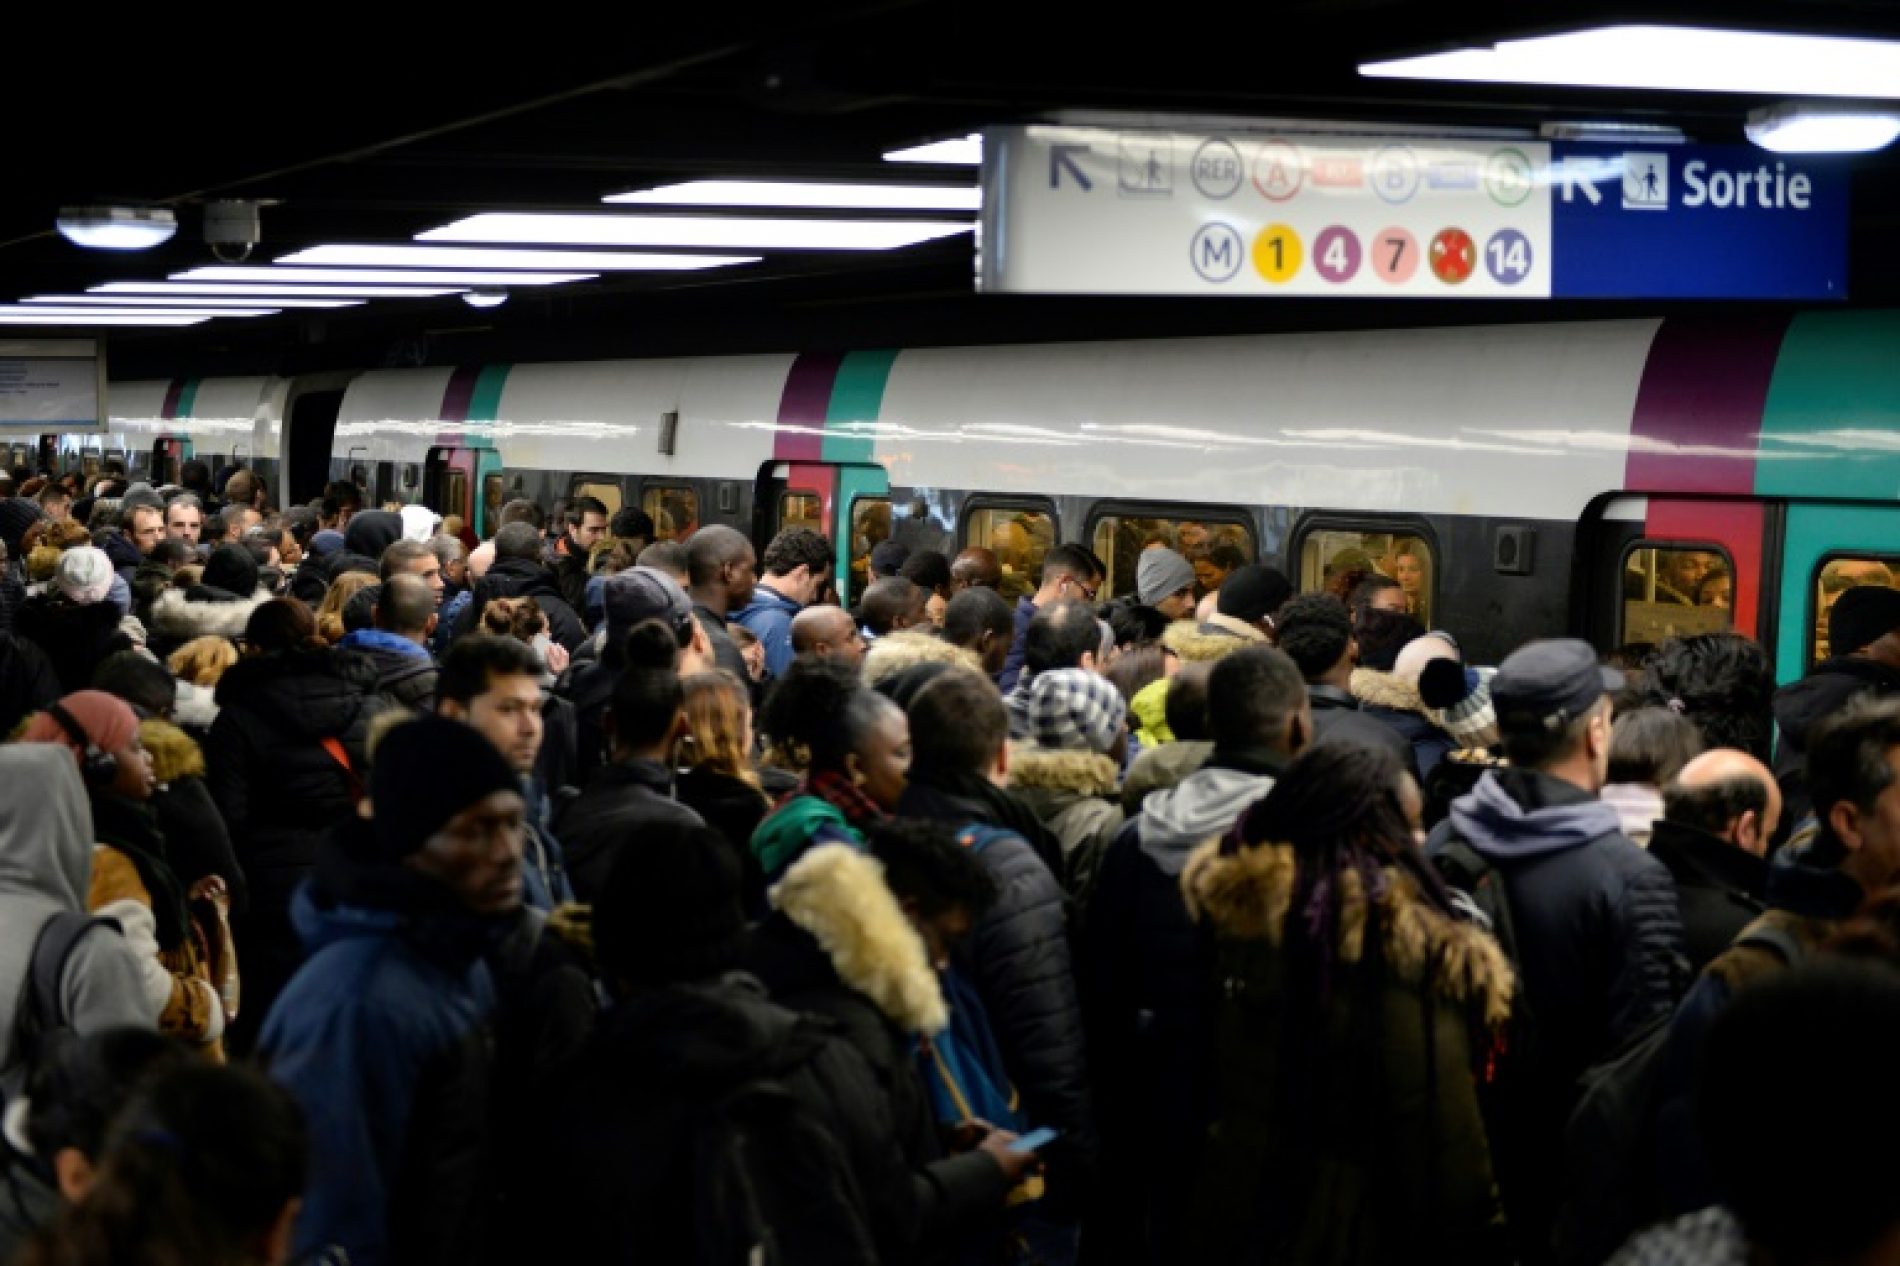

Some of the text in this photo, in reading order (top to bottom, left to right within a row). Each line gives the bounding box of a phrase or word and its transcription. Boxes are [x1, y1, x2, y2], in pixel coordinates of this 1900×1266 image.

[1199, 158, 1235, 180] RER
[1682, 160, 1812, 209] Sortie
[1204, 236, 1231, 268] M
[1268, 237, 1283, 270] 1
[1323, 235, 1348, 273] 4
[1385, 239, 1406, 272] 7
[1488, 239, 1527, 275] 14
